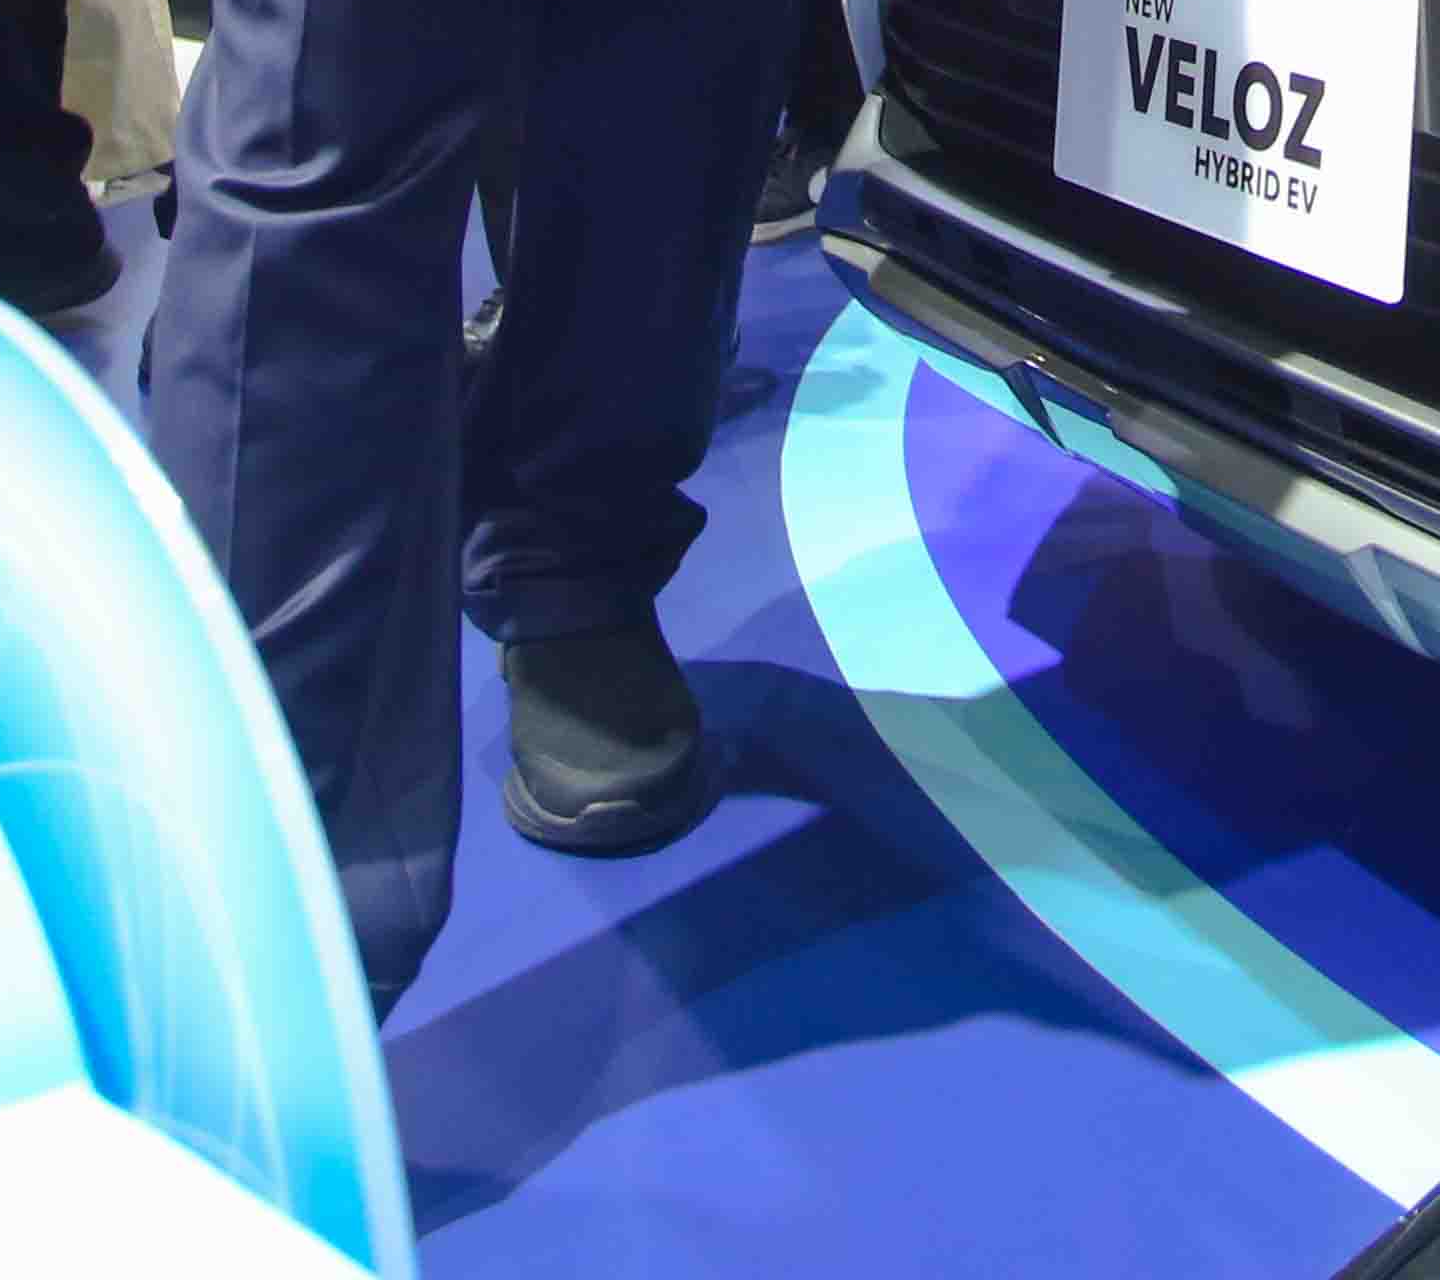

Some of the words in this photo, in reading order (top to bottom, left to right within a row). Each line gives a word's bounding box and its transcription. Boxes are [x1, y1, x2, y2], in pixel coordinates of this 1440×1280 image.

[1125, 25, 1326, 170] VELOZ
[1194, 146, 1281, 201] HYBRID
[1287, 177, 1318, 214] EV
